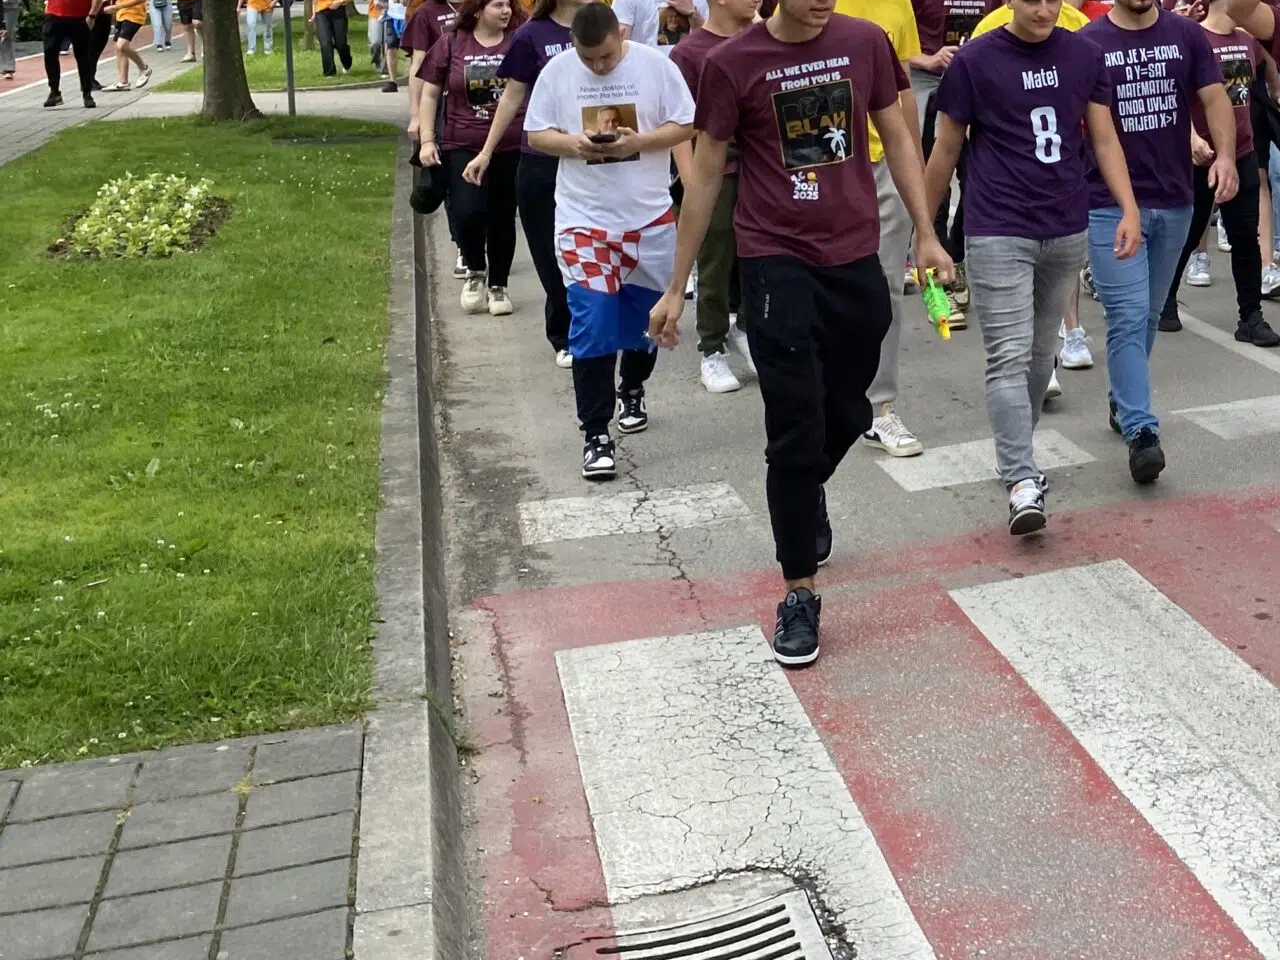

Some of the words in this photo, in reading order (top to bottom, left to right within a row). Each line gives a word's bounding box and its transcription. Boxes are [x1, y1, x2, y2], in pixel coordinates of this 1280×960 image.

[1104, 51, 1125, 67] AKO
[1126, 49, 1139, 64] JE
[1139, 44, 1183, 62] X=KAVA,
[765, 69, 783, 81] ALL
[784, 65, 801, 77] WE
[801, 60, 826, 74] EVER
[826, 56, 850, 69] HEAR
[1022, 66, 1059, 90] Matej
[1125, 66, 1133, 81] A
[1134, 62, 1167, 80] Y=SAT
[780, 78, 809, 91] FROM
[810, 73, 831, 85] YOU
[831, 71, 842, 81] IS
[1116, 78, 1178, 100] MATEMATIKE,
[1118, 99, 1145, 116] ONDA
[1146, 94, 1178, 113] UVIJEK
[1121, 113, 1158, 133] VRIJEDI
[1160, 111, 1178, 129] X>Y
[1030, 106, 1061, 163] 8
[793, 190, 819, 200] 2025
